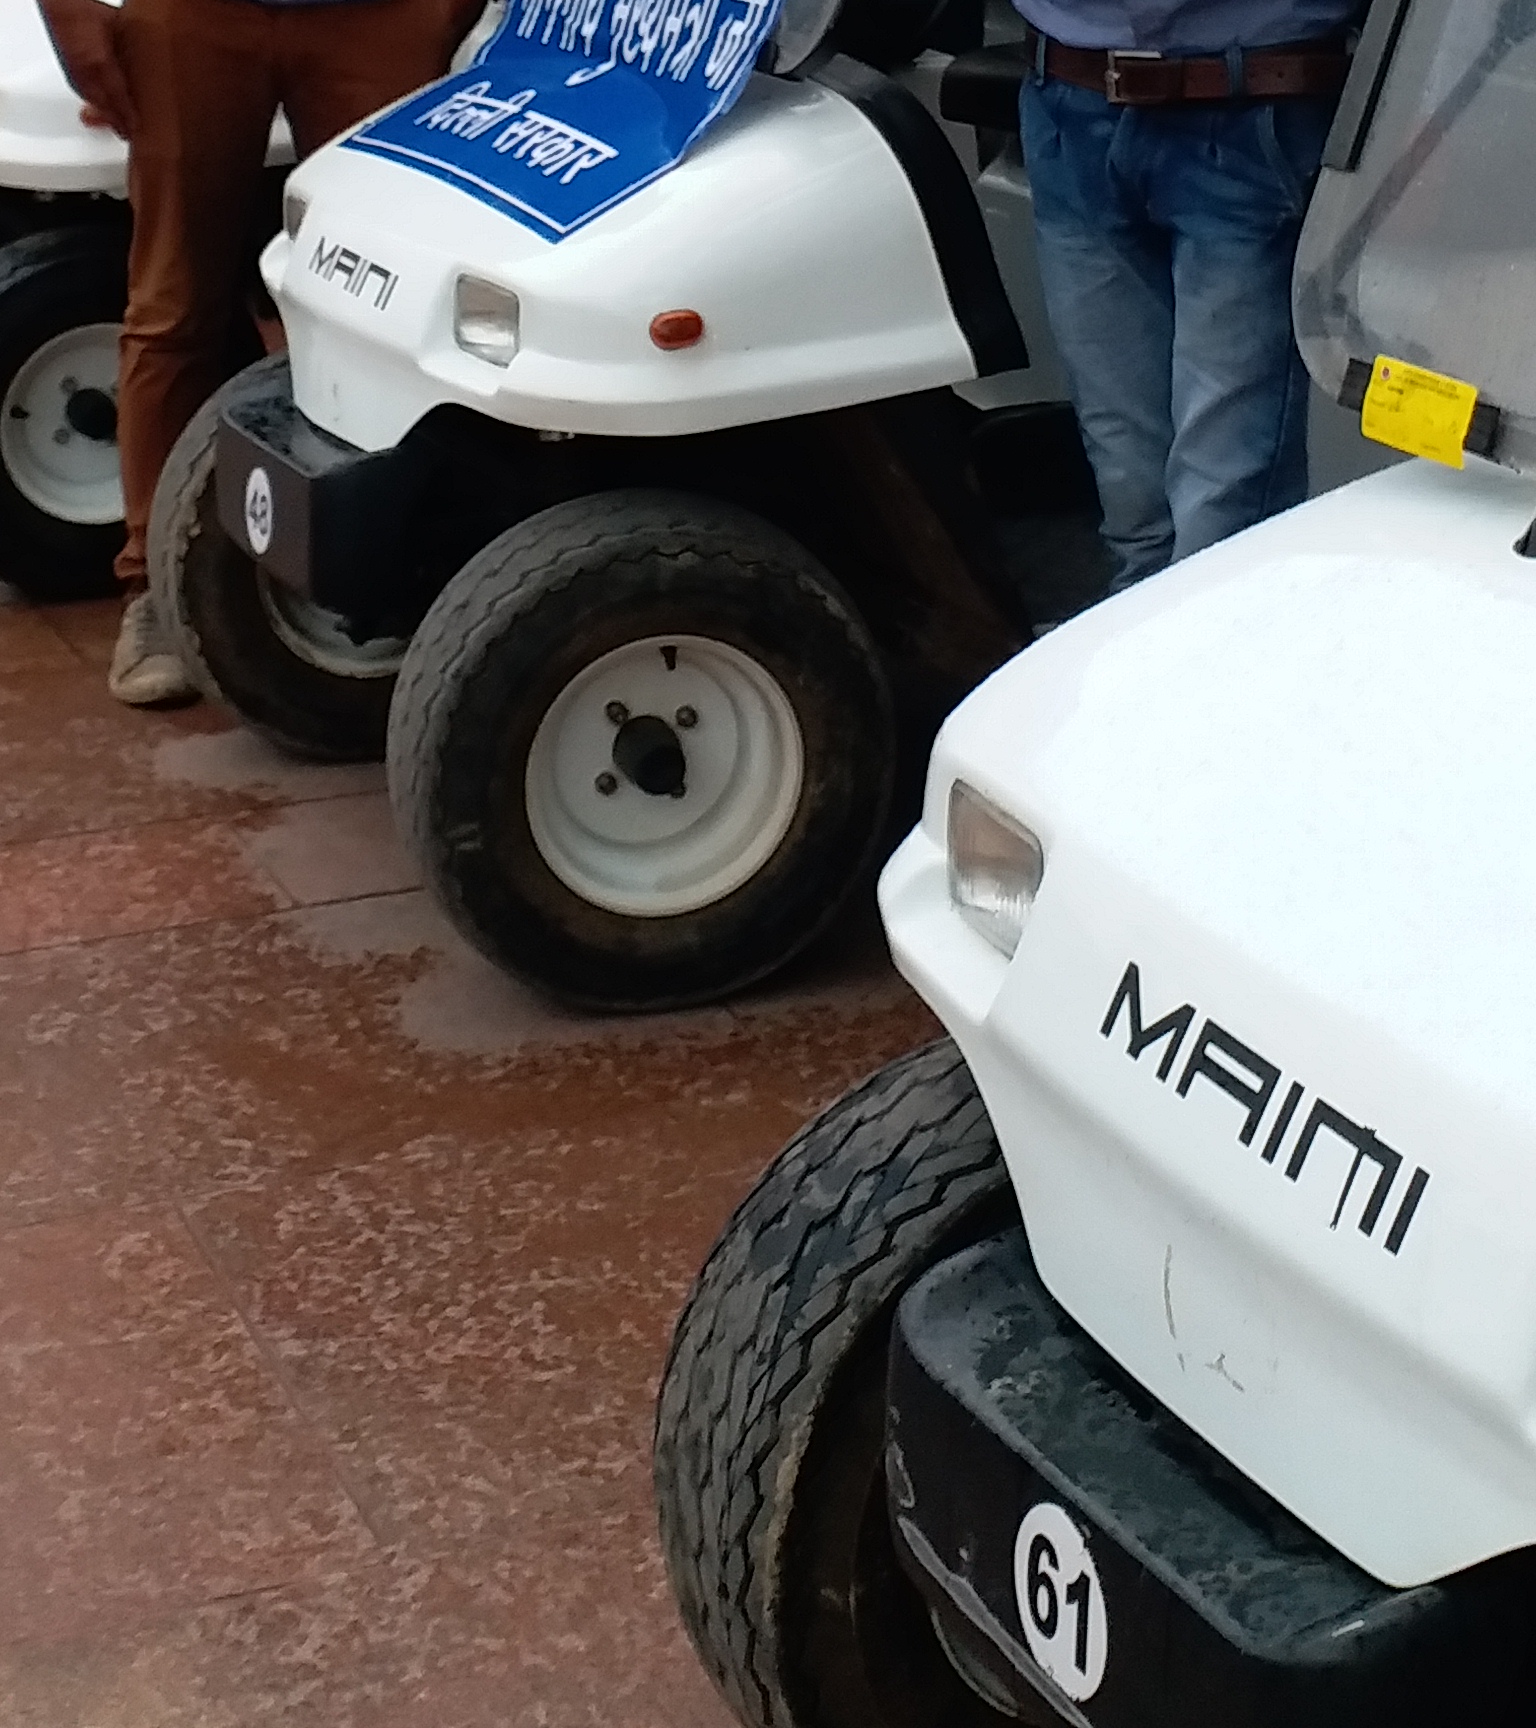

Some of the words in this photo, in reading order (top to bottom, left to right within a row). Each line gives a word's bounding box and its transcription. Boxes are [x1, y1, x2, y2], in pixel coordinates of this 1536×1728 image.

[490, 109, 620, 185] सरकार
[308, 235, 400, 312] MAINI
[1099, 959, 1432, 1257] MAINI
[1026, 1532, 1092, 1678] 61
